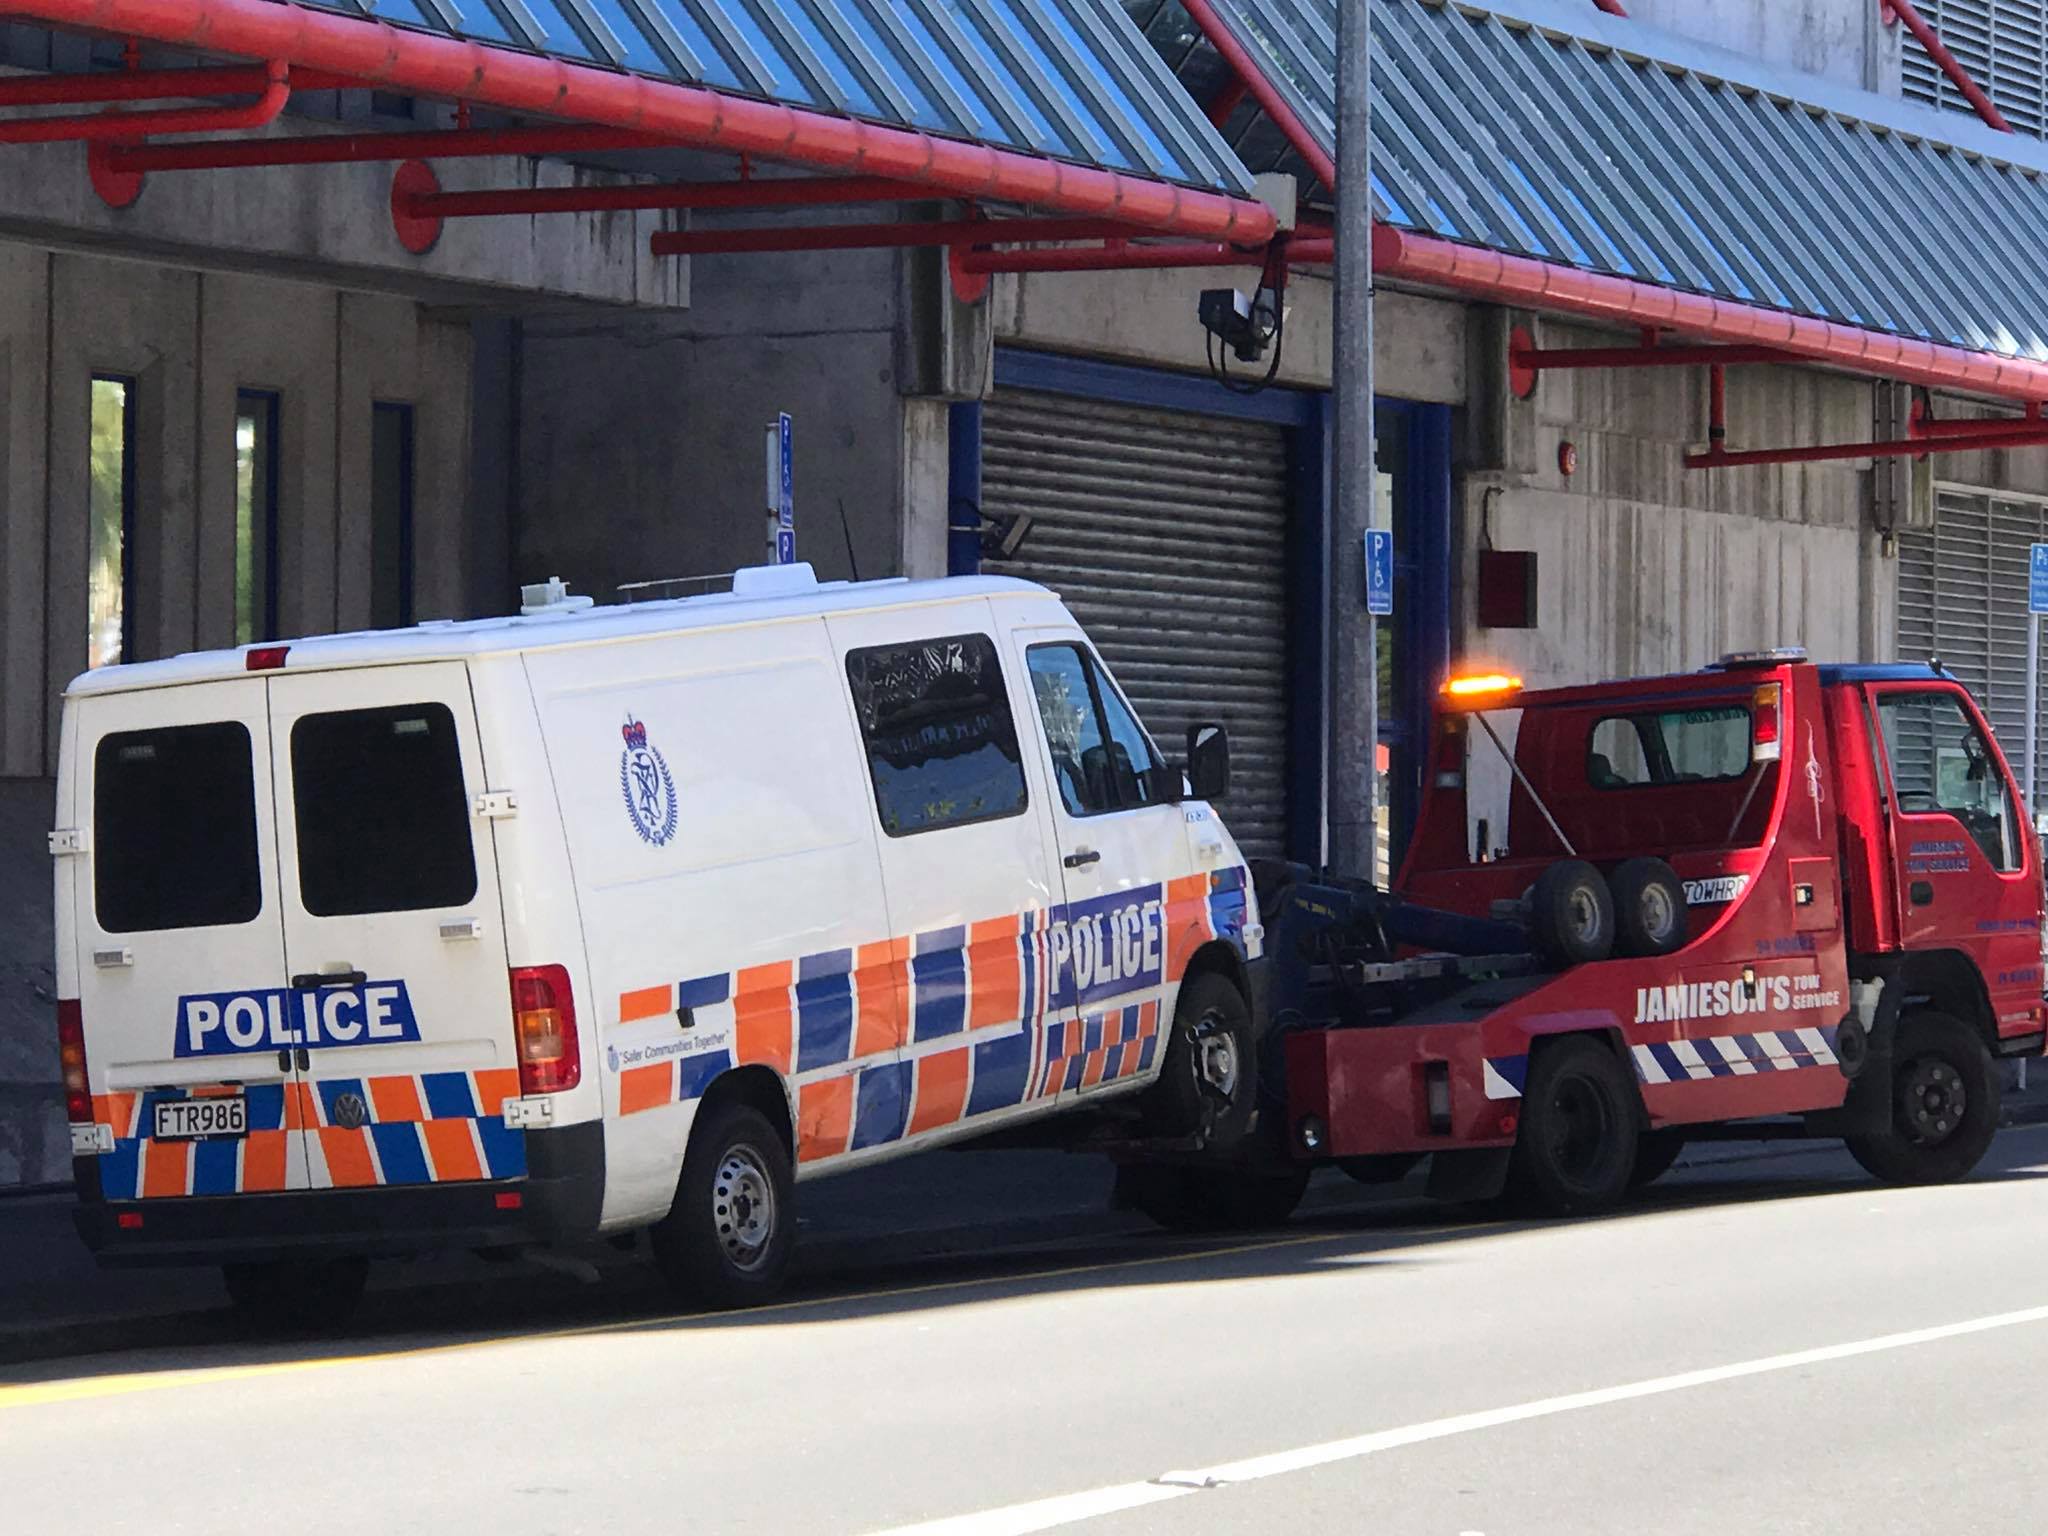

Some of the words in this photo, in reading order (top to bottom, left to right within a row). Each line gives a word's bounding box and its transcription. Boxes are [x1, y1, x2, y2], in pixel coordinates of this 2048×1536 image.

[782, 534, 790, 562] P
[1374, 534, 1384, 558] P
[1050, 900, 1160, 995] POLICE
[1792, 974, 1821, 991] TOW
[1634, 974, 1791, 1024] JAMIESON'S
[1791, 990, 1840, 1010] SERVICE
[186, 986, 403, 1051] POLICE
[158, 1102, 243, 1134] FTR986
